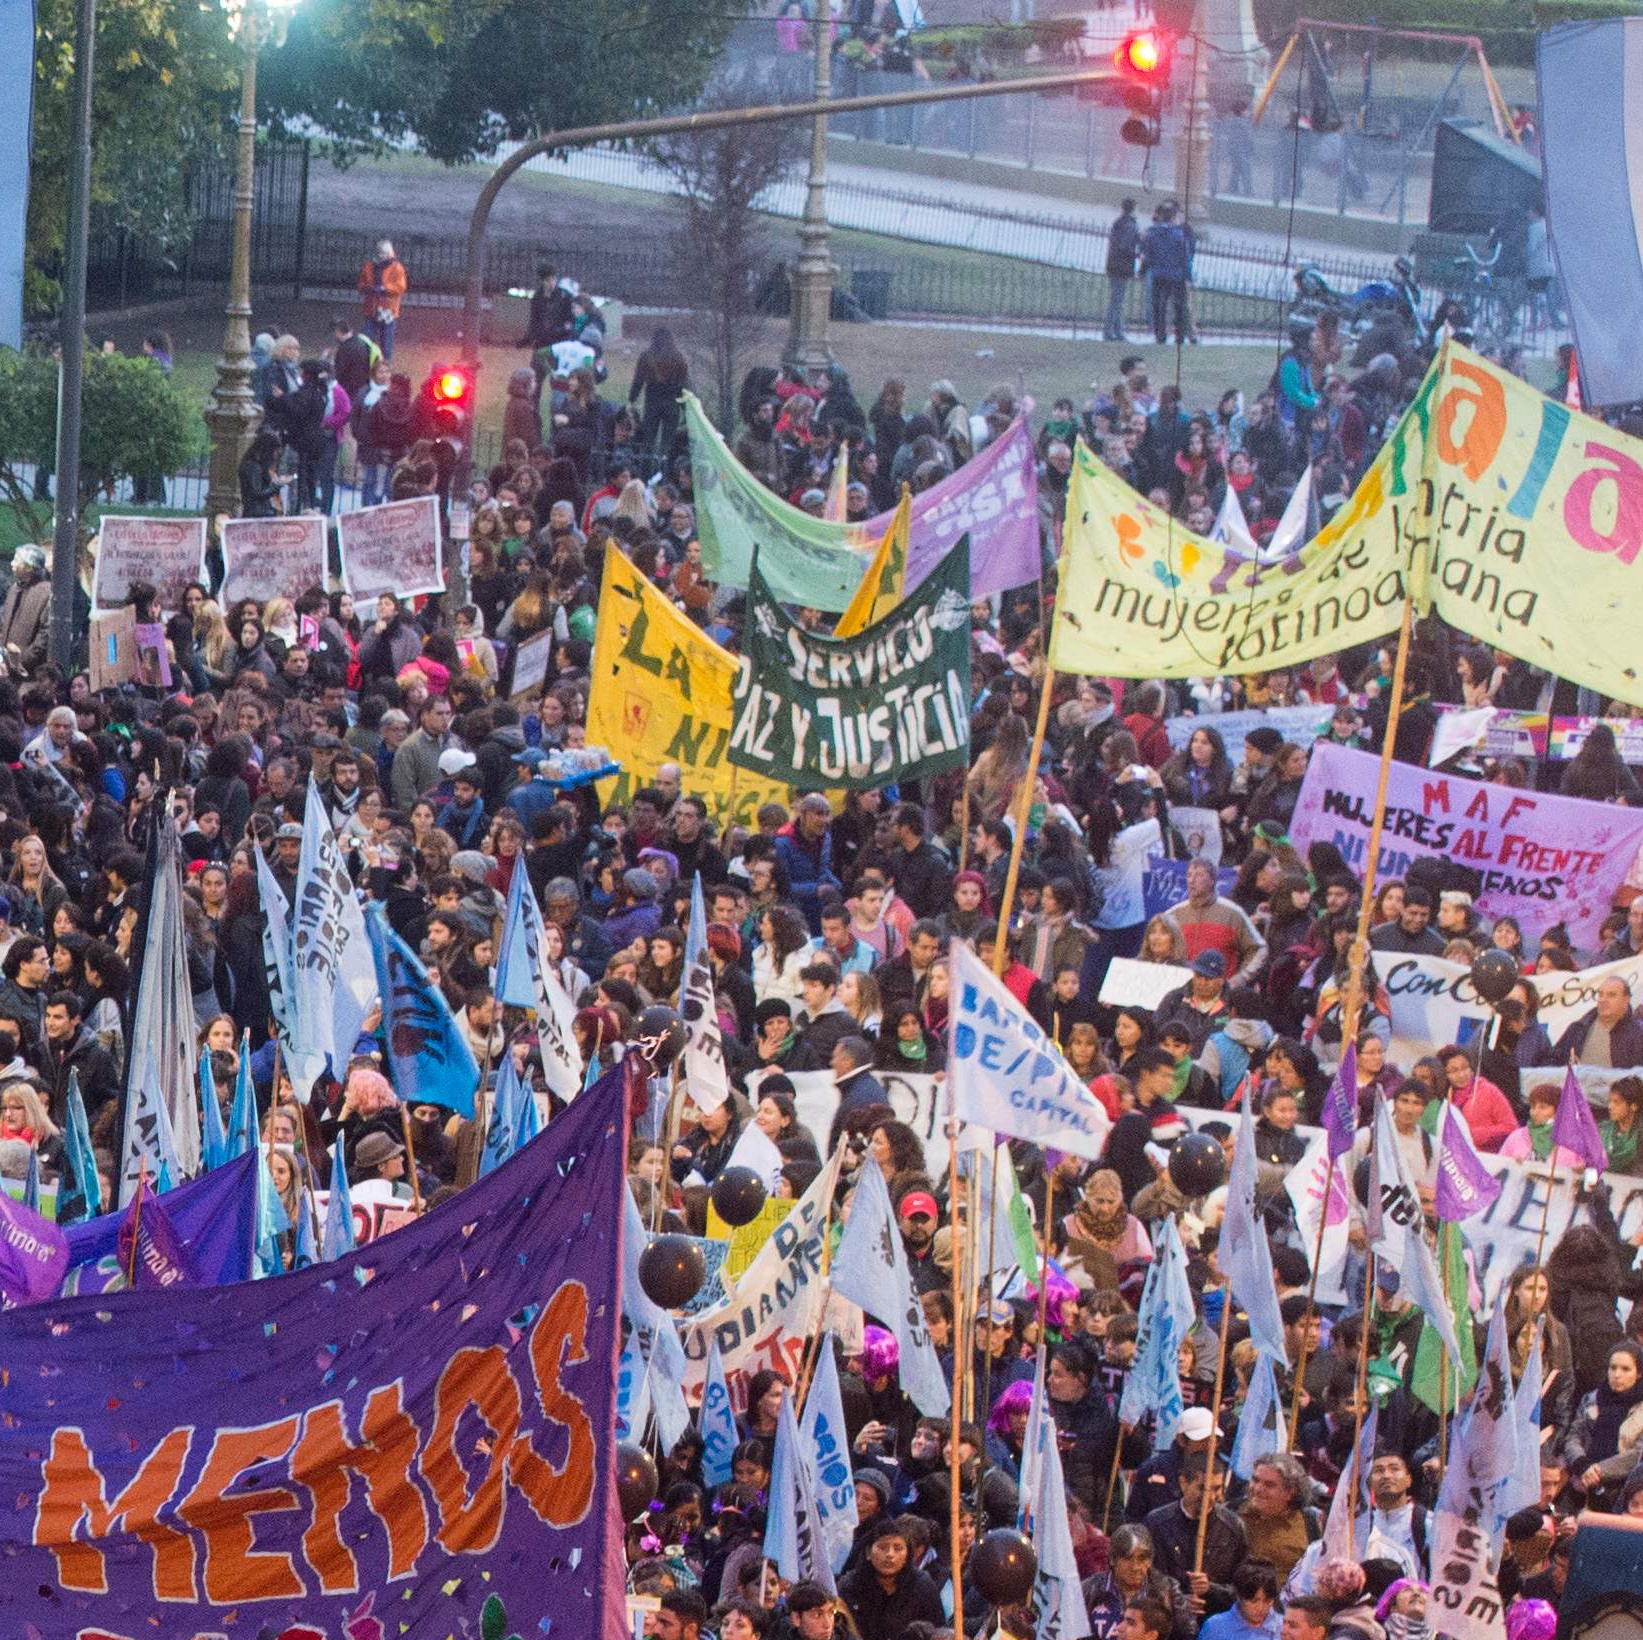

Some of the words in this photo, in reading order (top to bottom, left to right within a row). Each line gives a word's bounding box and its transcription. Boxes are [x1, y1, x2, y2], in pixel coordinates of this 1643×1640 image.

[732, 656, 782, 761] PAZ
[791, 703, 812, 770] Y
[1321, 789, 1456, 850] MUJERES
[1453, 830, 1494, 862] AL
[1498, 834, 1608, 875] FRENTE
[1423, 780, 1451, 818] M
[1466, 789, 1490, 823] A
[1501, 796, 1538, 829] F
[31, 1279, 596, 1606] MENOS
